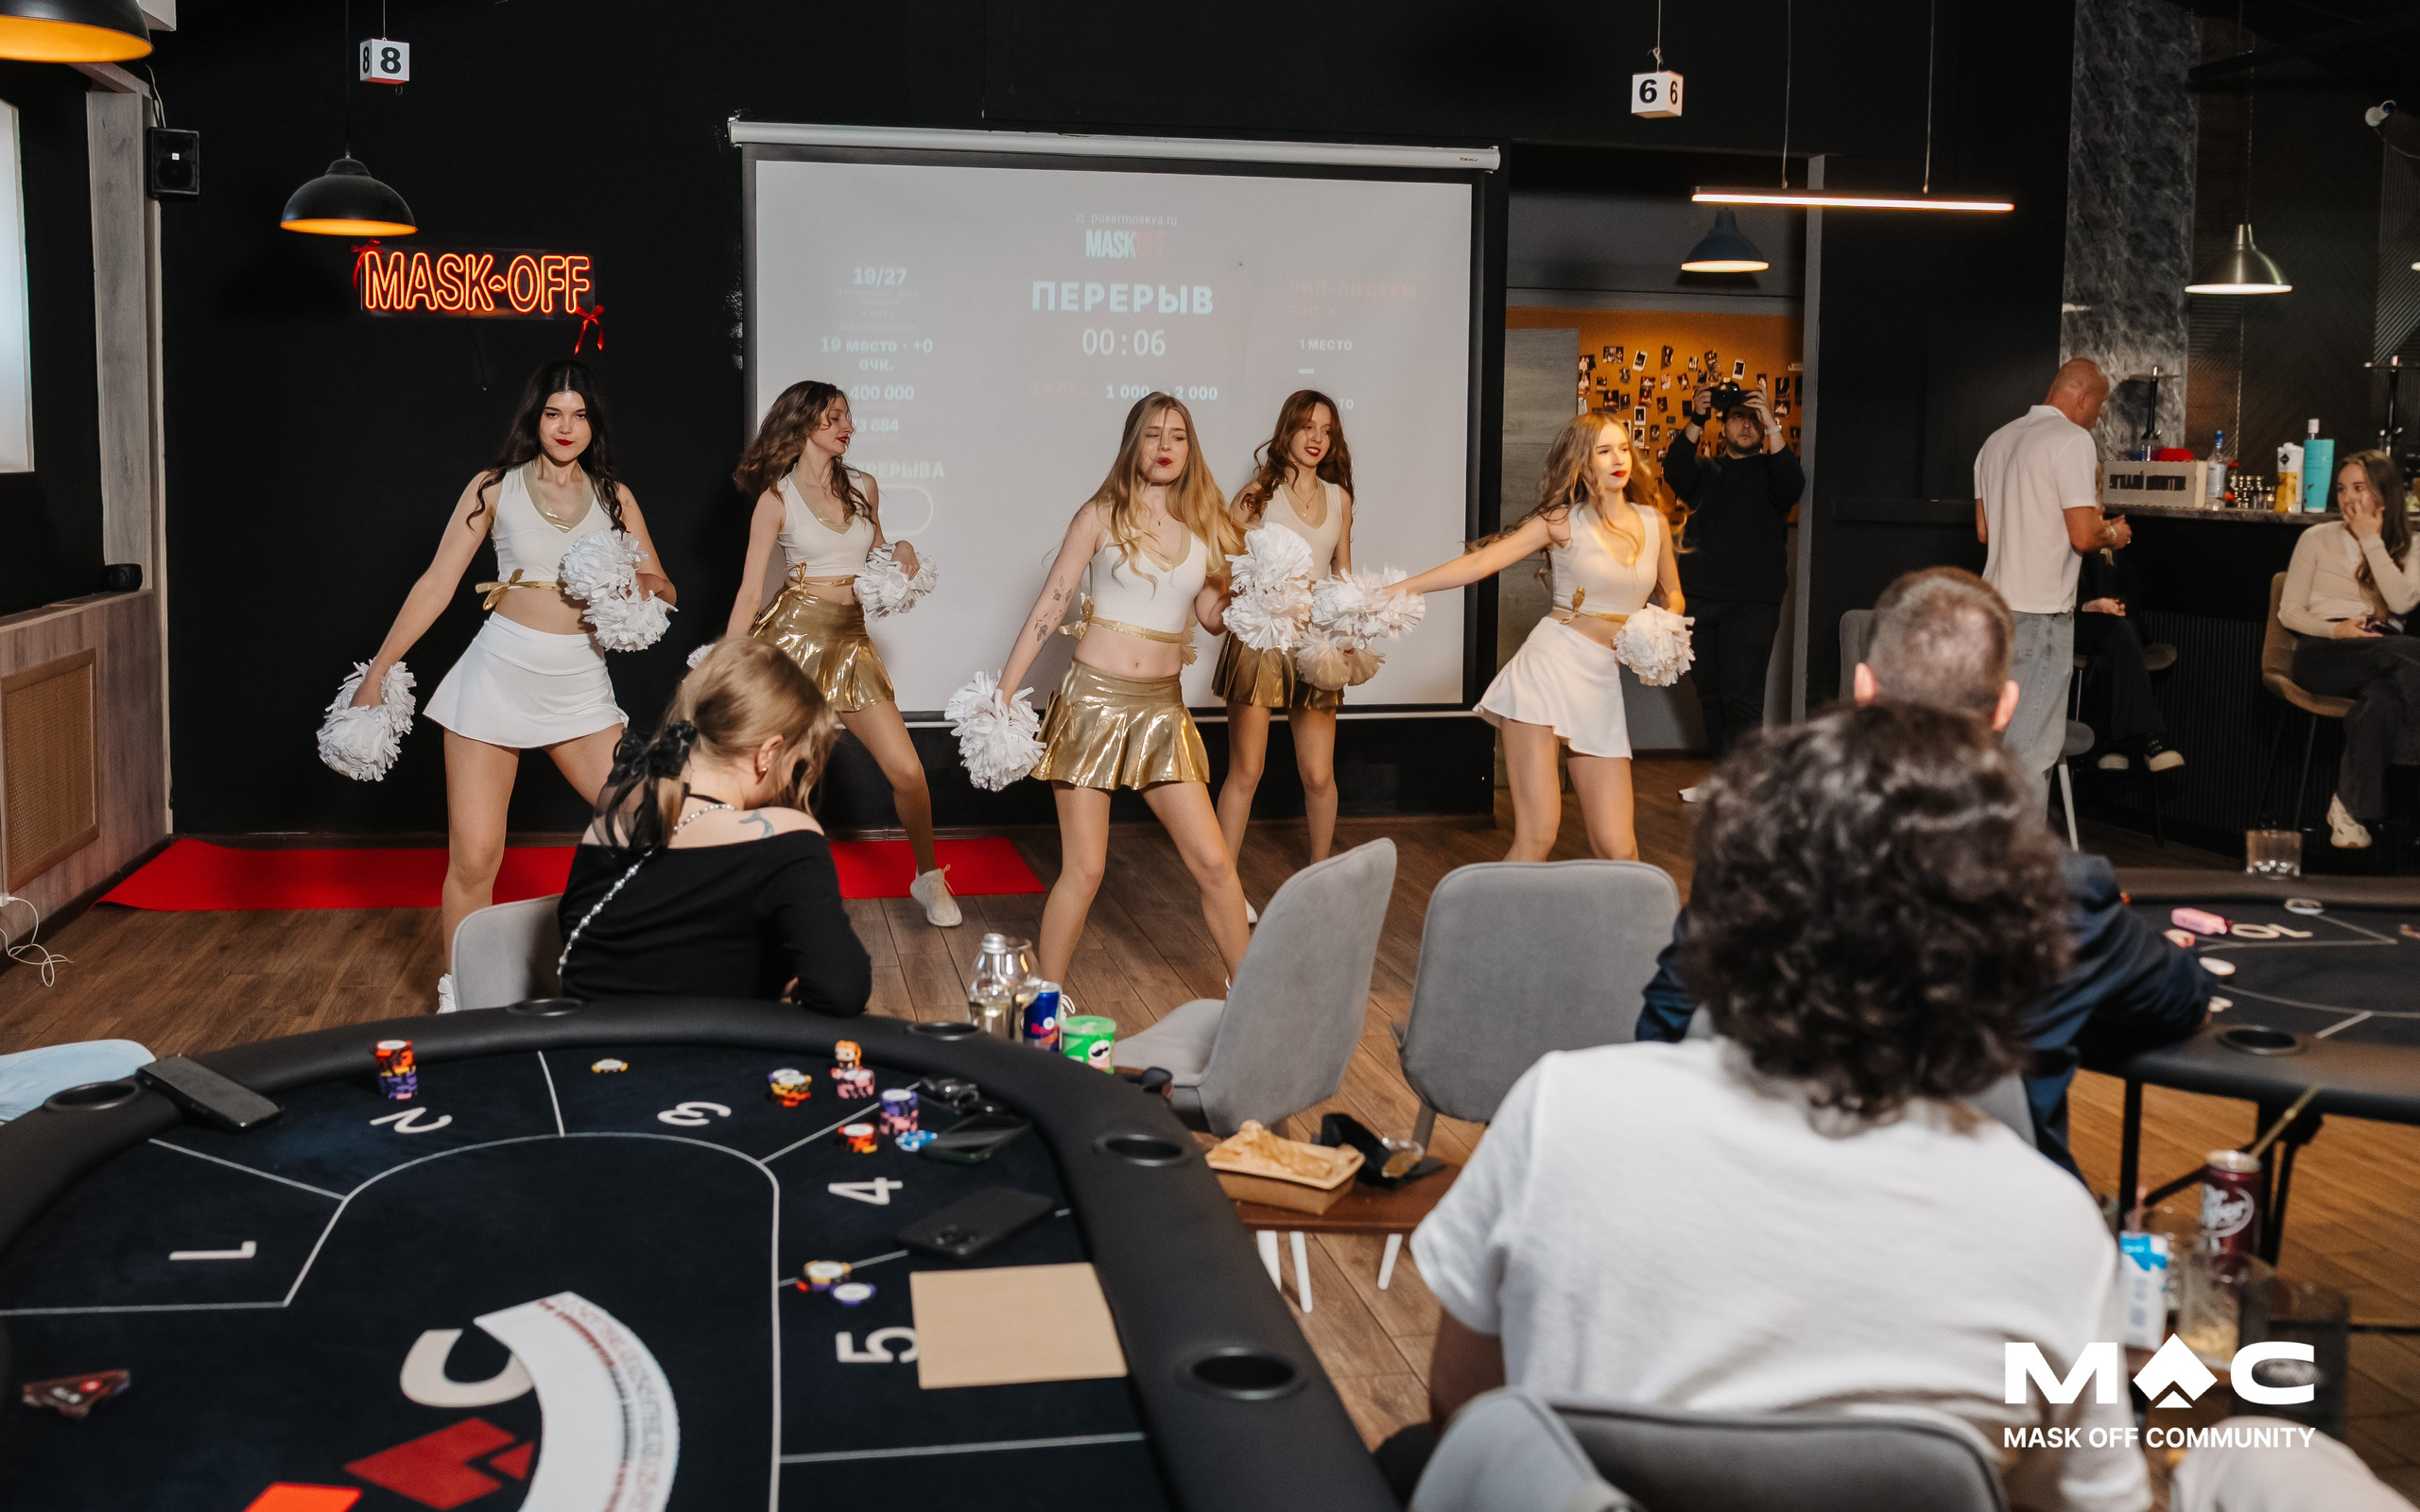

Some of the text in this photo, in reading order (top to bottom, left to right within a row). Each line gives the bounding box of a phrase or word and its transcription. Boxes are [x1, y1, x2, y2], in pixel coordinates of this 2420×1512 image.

[362, 46, 370, 74] 8
[380, 46, 402, 75] 8
[1638, 78, 1657, 104] 6
[1669, 80, 1678, 105] 6
[1091, 214, 1178, 226] pokermoskva.ru
[853, 266, 908, 287] 19/27
[1031, 281, 1214, 316] ПЕРЕРЫВ
[821, 336, 933, 353] 19 место +0
[1081, 328, 1167, 356] 00:06
[1299, 339, 1353, 352] 1 МЕСТО
[859, 358, 892, 371] очк.
[850, 385, 914, 401] 400 000
[1106, 385, 1115, 399] 1
[1120, 385, 1150, 400] 000
[1188, 386, 1218, 401] 000
[370, 1108, 452, 1134] 2
[657, 1101, 732, 1126] 3
[828, 1177, 903, 1206] 4
[169, 1240, 256, 1261] 1
[835, 1326, 919, 1364] 5
